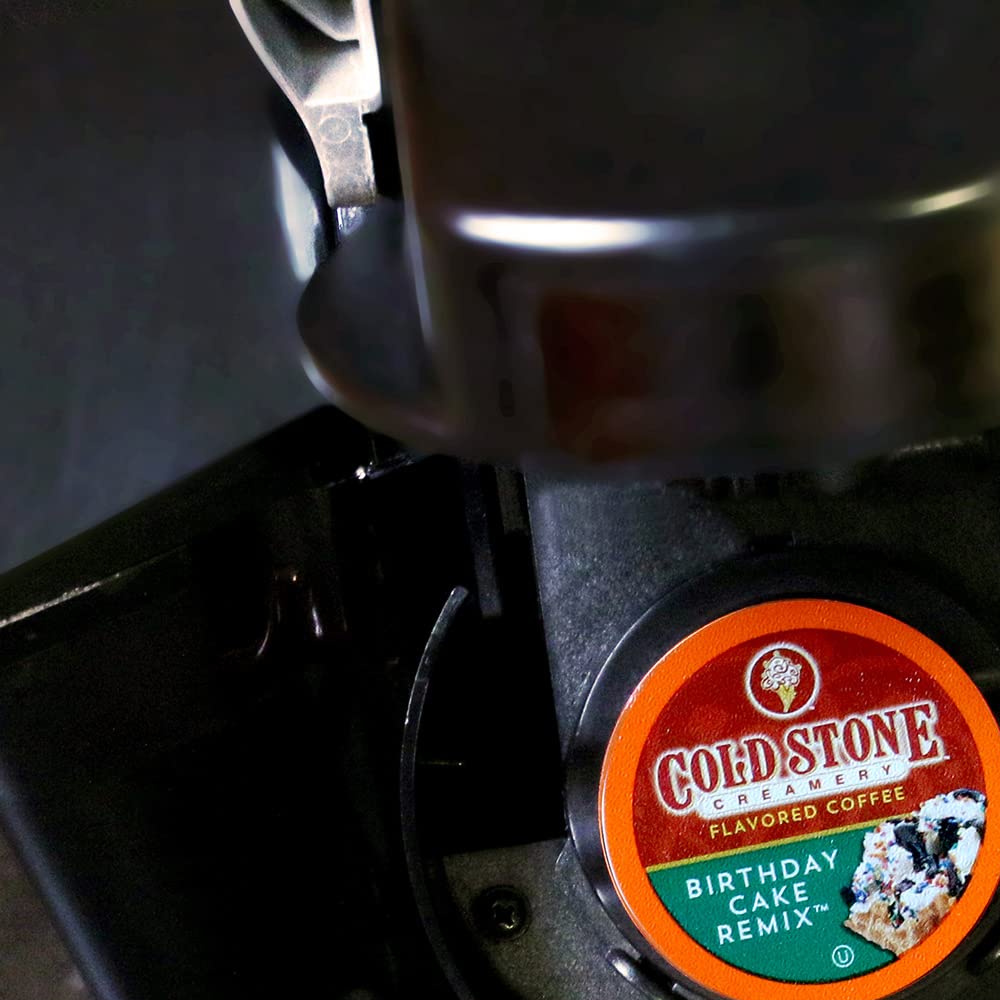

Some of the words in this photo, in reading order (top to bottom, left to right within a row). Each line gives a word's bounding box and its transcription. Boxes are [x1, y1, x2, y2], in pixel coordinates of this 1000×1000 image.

[656, 735, 778, 811] COLD
[785, 702, 940, 775] STONE
[708, 804, 818, 840] FLAVORED
[826, 786, 906, 815] COFFEE
[712, 763, 893, 811] CREAMERY
[685, 848, 839, 900] BIRTHDAY
[728, 881, 810, 916] CAKE
